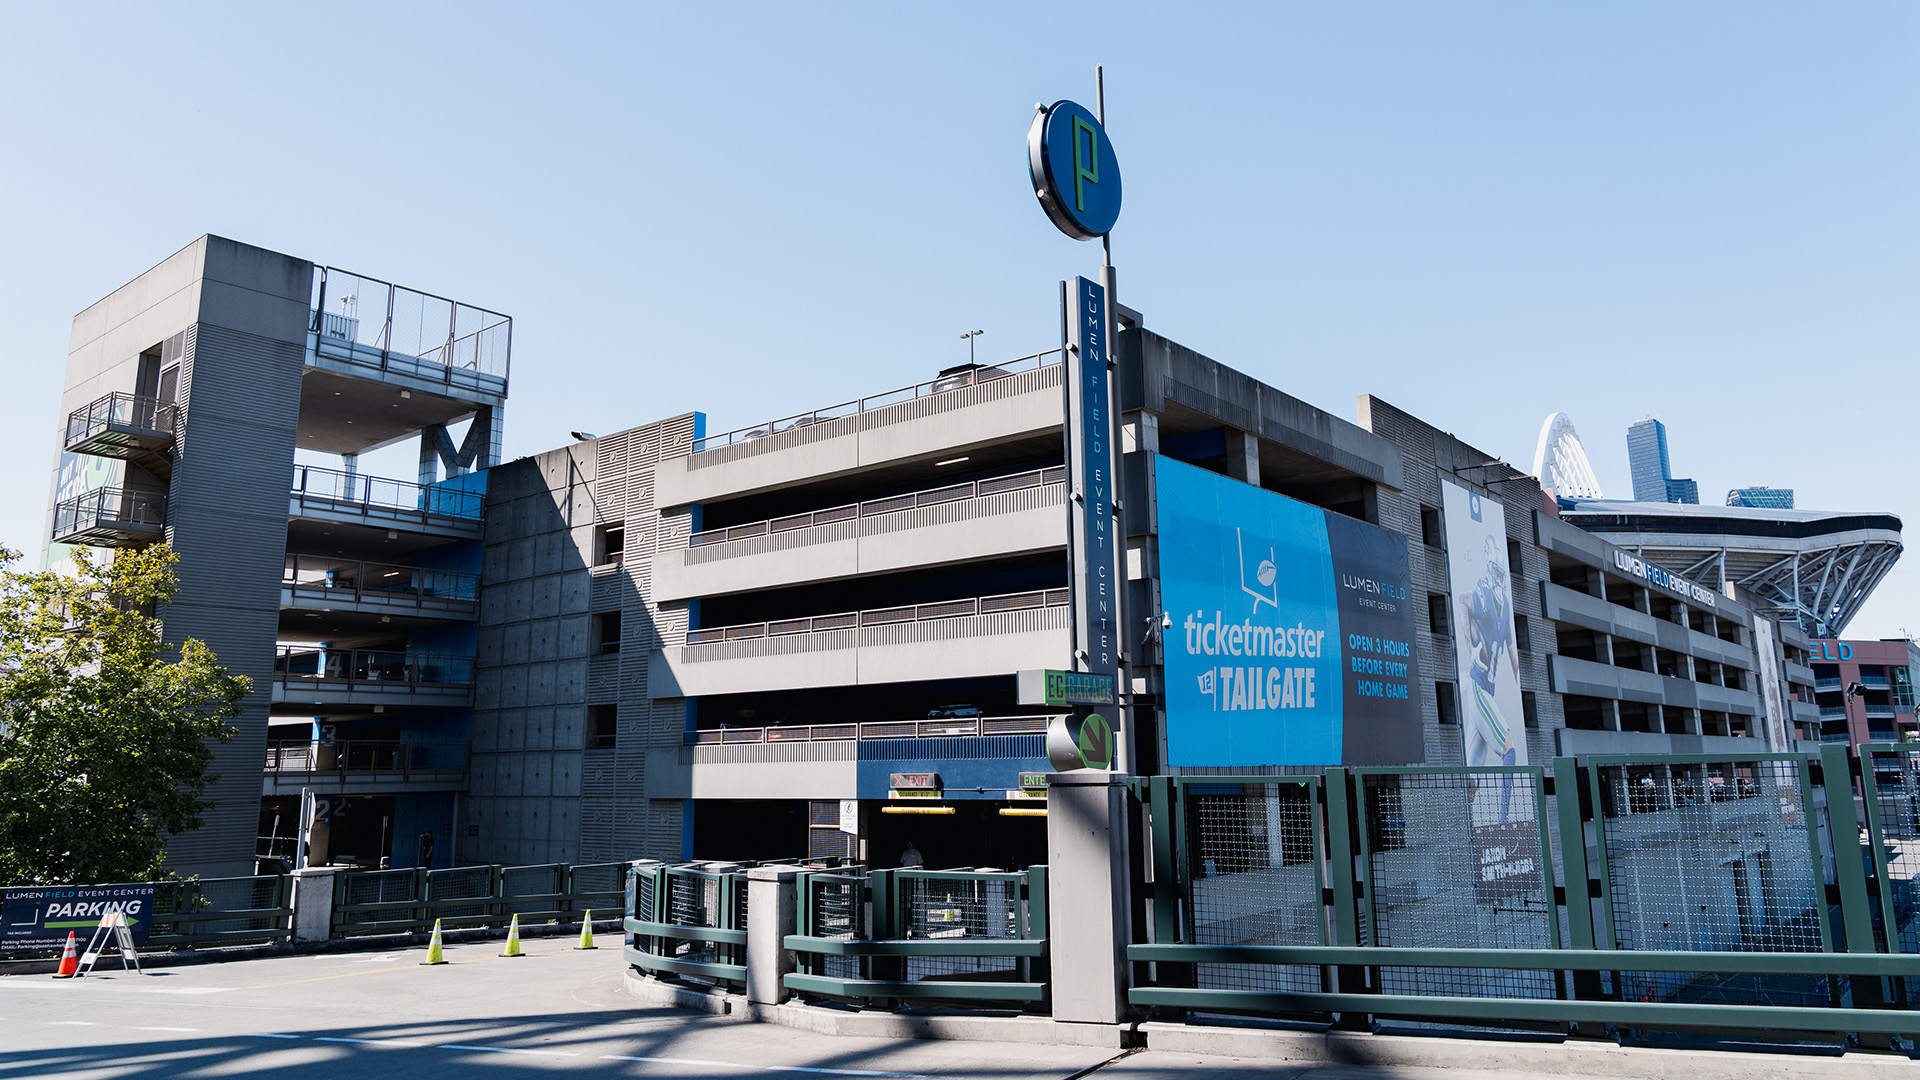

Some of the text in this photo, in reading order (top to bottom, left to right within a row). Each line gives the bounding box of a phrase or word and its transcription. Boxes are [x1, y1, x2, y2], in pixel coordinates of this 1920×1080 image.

[1072, 114, 1098, 212] P
[1088, 285, 1109, 665] LUMEN FIELD EVENT CENTER
[1343, 573, 1406, 600] LUMEN FIELD
[1613, 550, 1716, 607] LUMEN FIELD EVENT CENTER
[1359, 597, 1396, 612] EVENT CENTER
[1183, 610, 1324, 658] ticketmaster
[1349, 633, 1410, 657] OPEN 3 HOURS
[326, 652, 342, 678] 4
[1351, 656, 1408, 678] BEFORE EVERY
[1048, 675, 1113, 701] EC GARAGE
[1220, 666, 1315, 711] TAILGATE
[1358, 680, 1409, 699] HOME GAME
[320, 724, 336, 747] 3
[909, 775, 927, 786] EXIT
[1024, 774, 1048, 786] ENTE
[316, 800, 330, 822] 2
[45, 890, 75, 898] FIELD
[78, 889, 111, 897] EVENT
[113, 888, 154, 896] CENTER
[45, 900, 142, 918] PARKING
